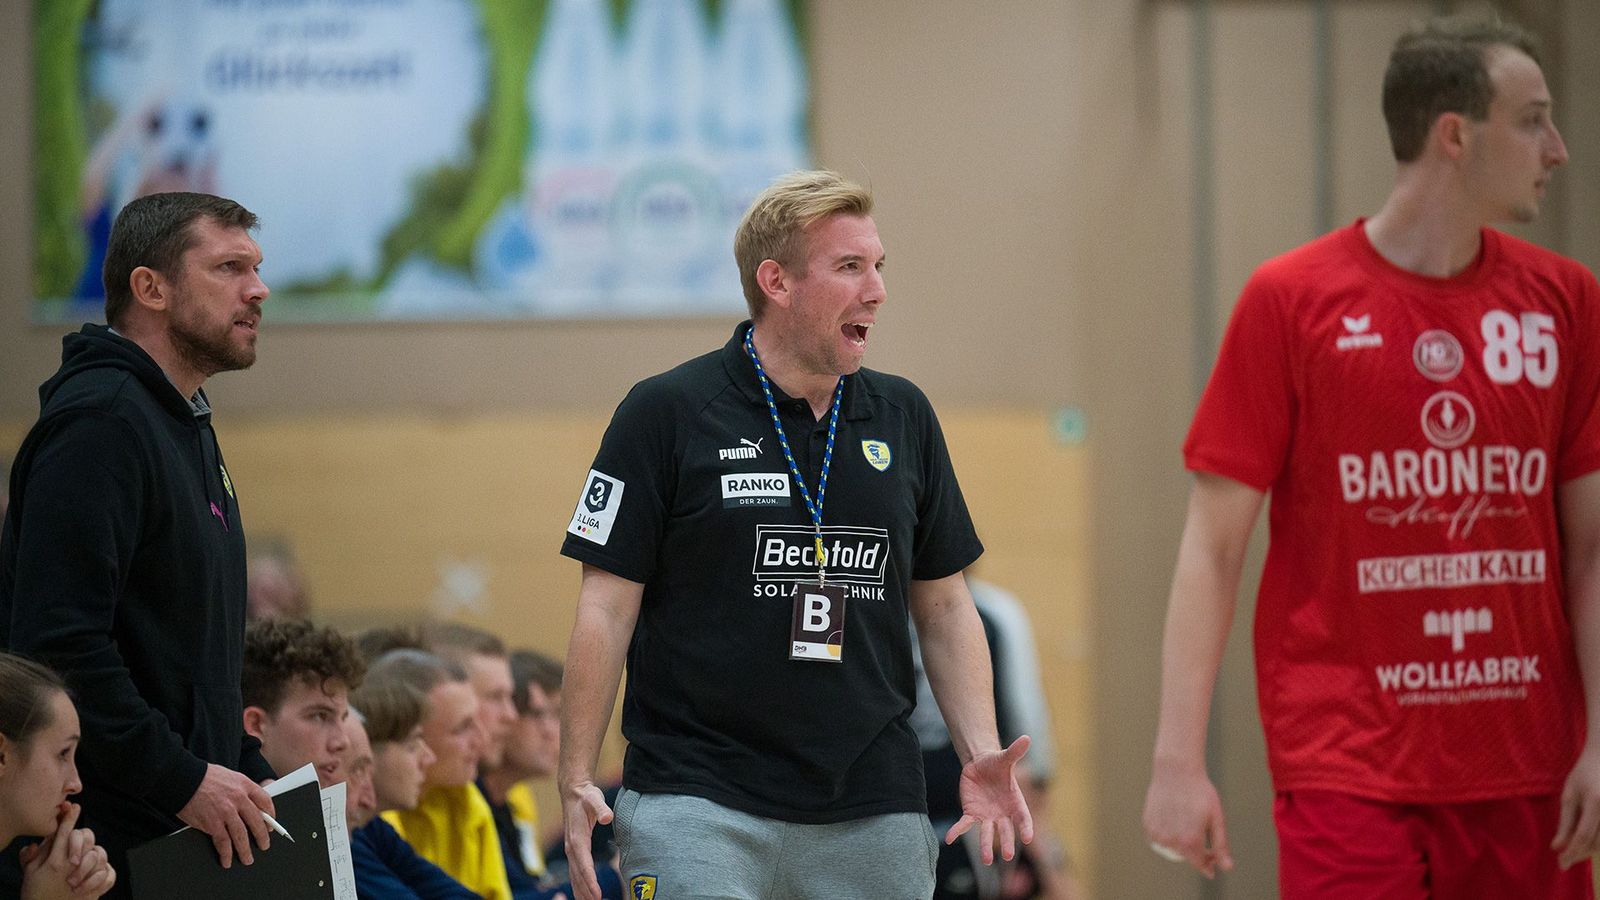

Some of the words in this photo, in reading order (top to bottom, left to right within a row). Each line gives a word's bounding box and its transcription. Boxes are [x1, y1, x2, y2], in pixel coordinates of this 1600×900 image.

[1480, 309, 1559, 389] 85
[719, 447, 757, 460] PUMA
[727, 478, 785, 493] RANKO
[582, 515, 600, 530] LIGA
[1363, 557, 1473, 587] KÜCHEN
[1478, 554, 1542, 580] KALL
[803, 593, 831, 632] B
